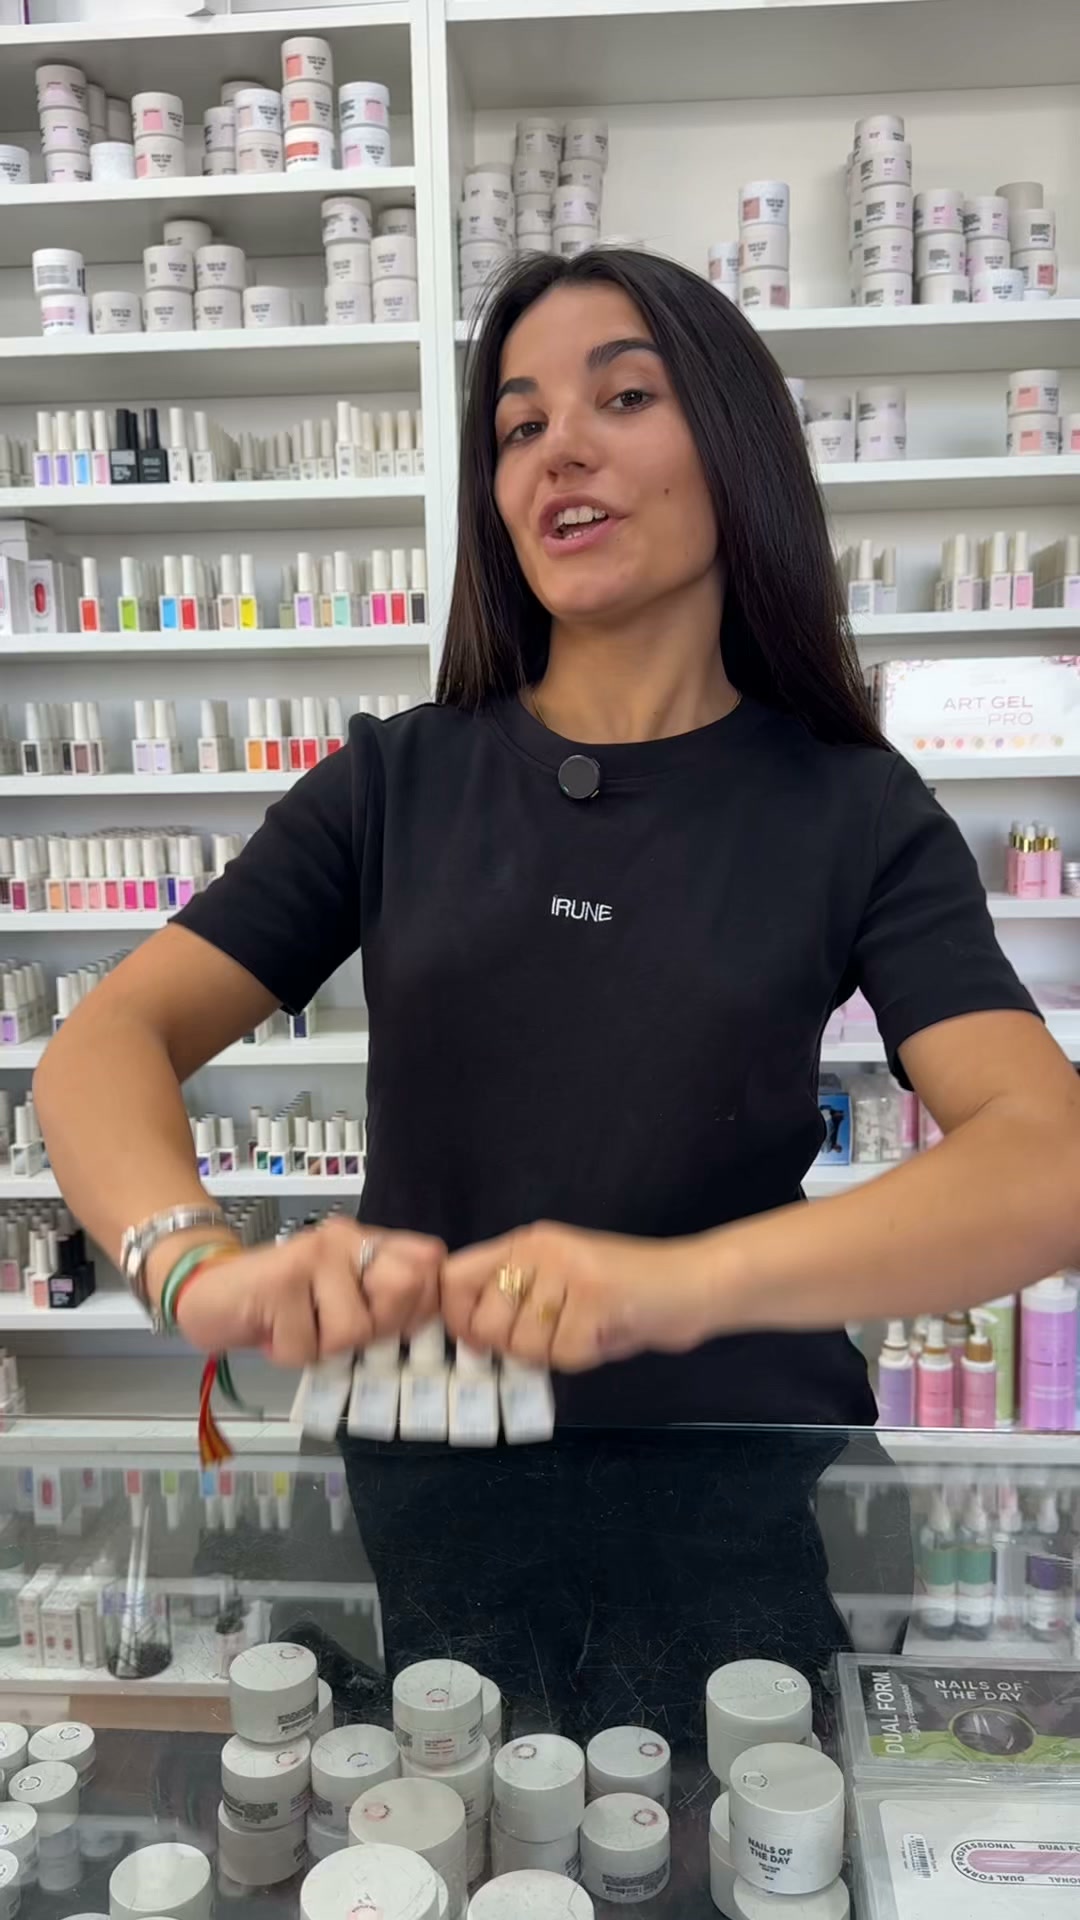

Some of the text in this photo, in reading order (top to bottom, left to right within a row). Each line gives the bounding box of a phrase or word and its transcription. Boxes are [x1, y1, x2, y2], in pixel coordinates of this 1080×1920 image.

[943, 695, 1033, 710] ART GEL
[988, 712, 1034, 726] PRO
[551, 895, 613, 922] IRUNE
[934, 1679, 1023, 1691] NAILS OF
[940, 1689, 1022, 1701] THE DAY
[872, 1671, 906, 1754] DUAL FORM
[748, 1836, 793, 1856] NAILS OF
[750, 1846, 790, 1865] THE DAY
[956, 1842, 1017, 1866] PROFESSIONAL
